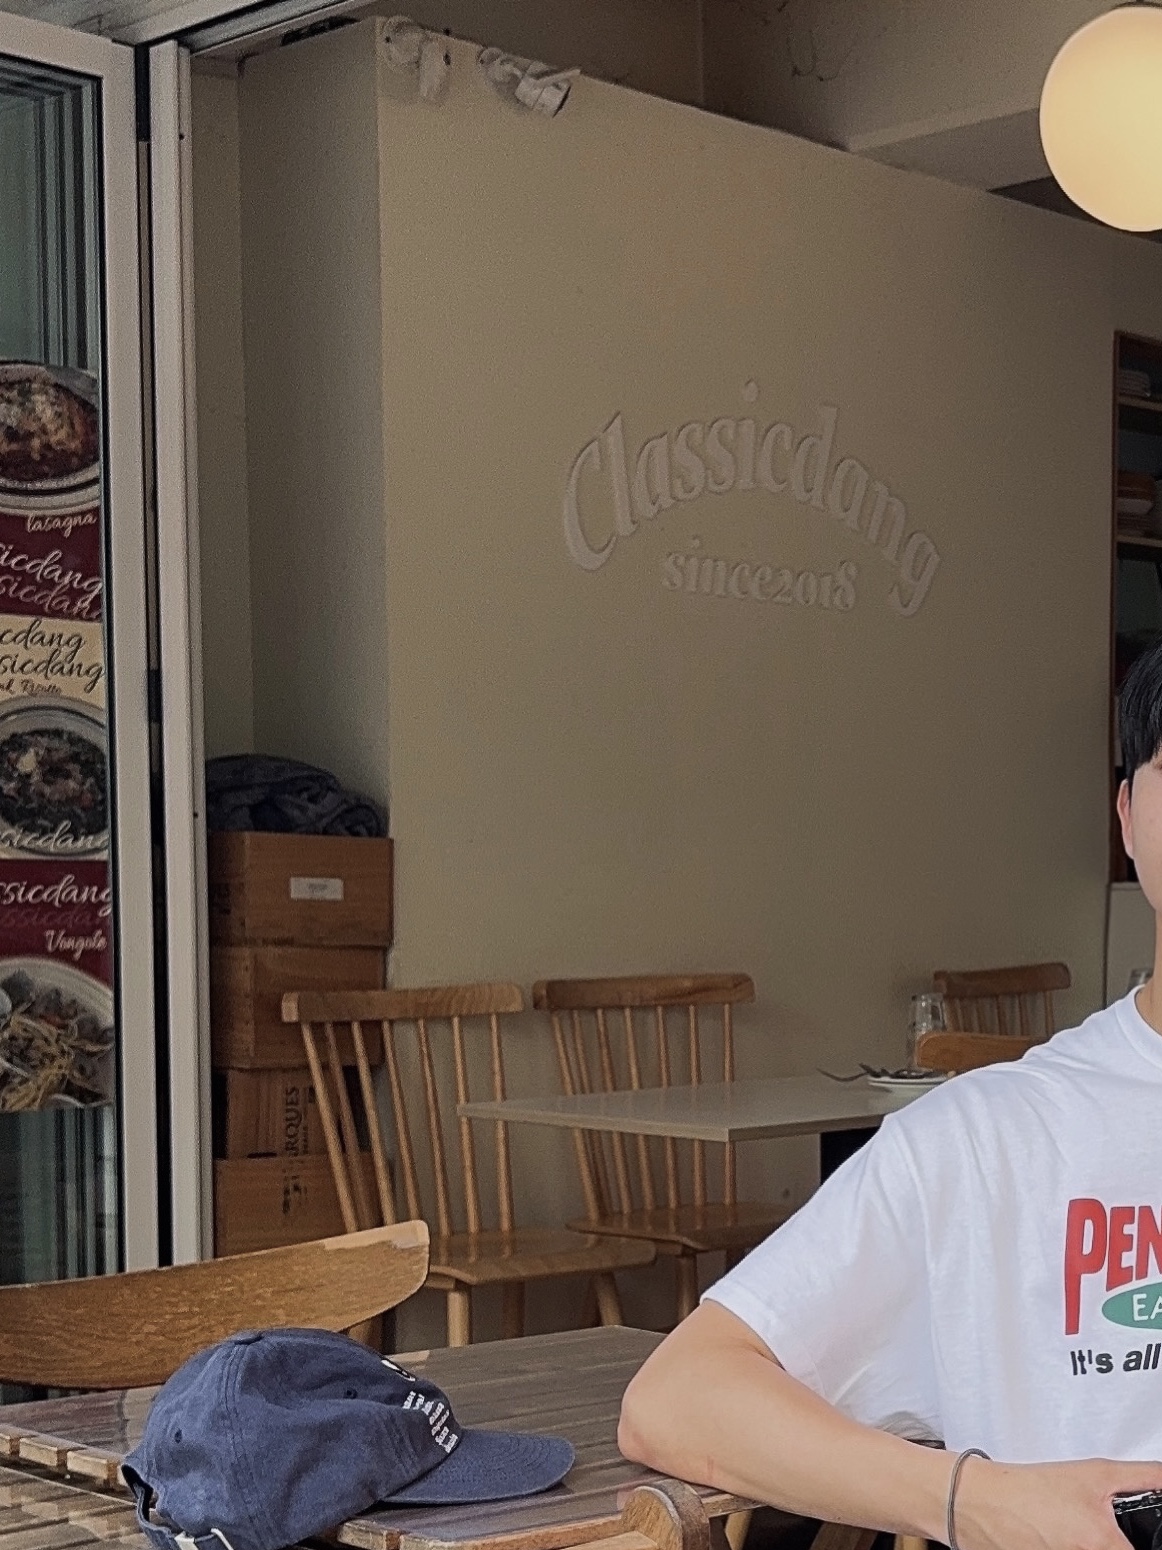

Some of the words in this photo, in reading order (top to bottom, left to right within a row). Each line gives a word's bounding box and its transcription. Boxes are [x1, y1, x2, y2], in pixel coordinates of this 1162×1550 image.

[564, 378, 940, 617] Classicdang
[0, 543, 103, 614] icdang
[1069, 1349, 1114, 1376] It's
[1122, 1342, 1162, 1372] all
